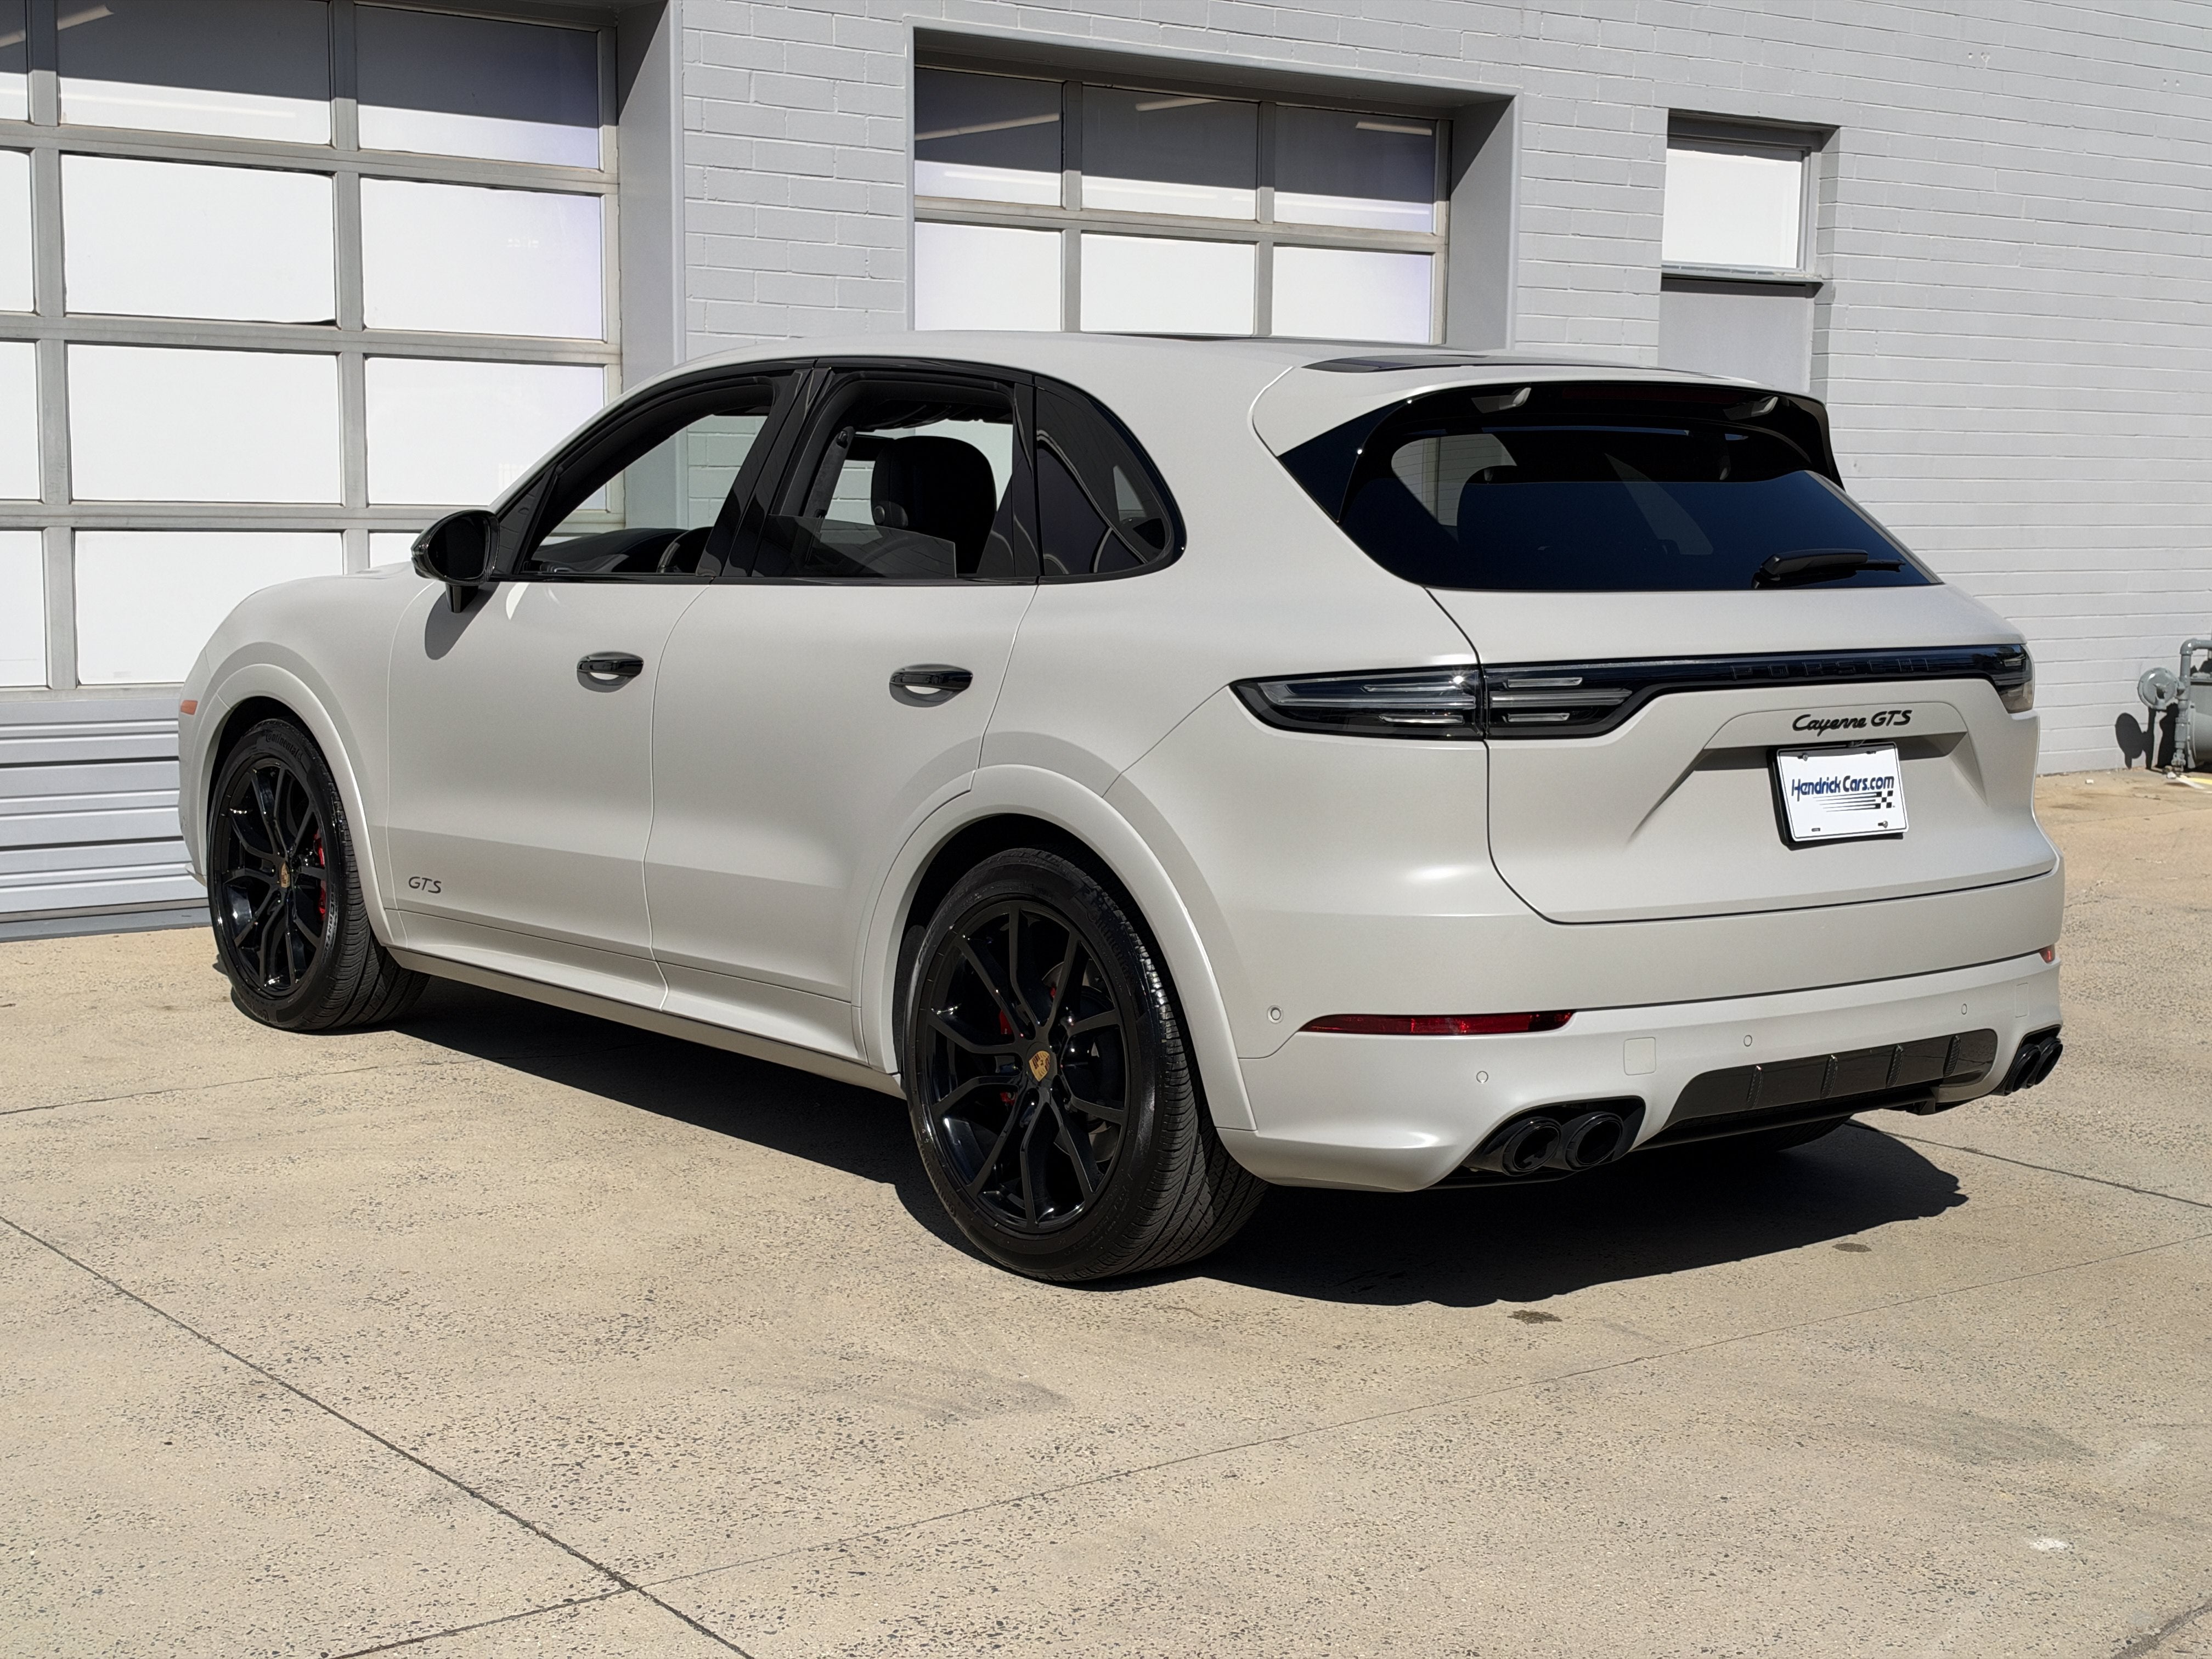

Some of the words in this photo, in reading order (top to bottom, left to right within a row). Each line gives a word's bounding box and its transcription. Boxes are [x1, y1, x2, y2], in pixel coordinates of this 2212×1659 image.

[1792, 714, 1867, 737] Cayenne
[1871, 710, 1912, 726] GTS
[408, 876, 442, 894] GTS
